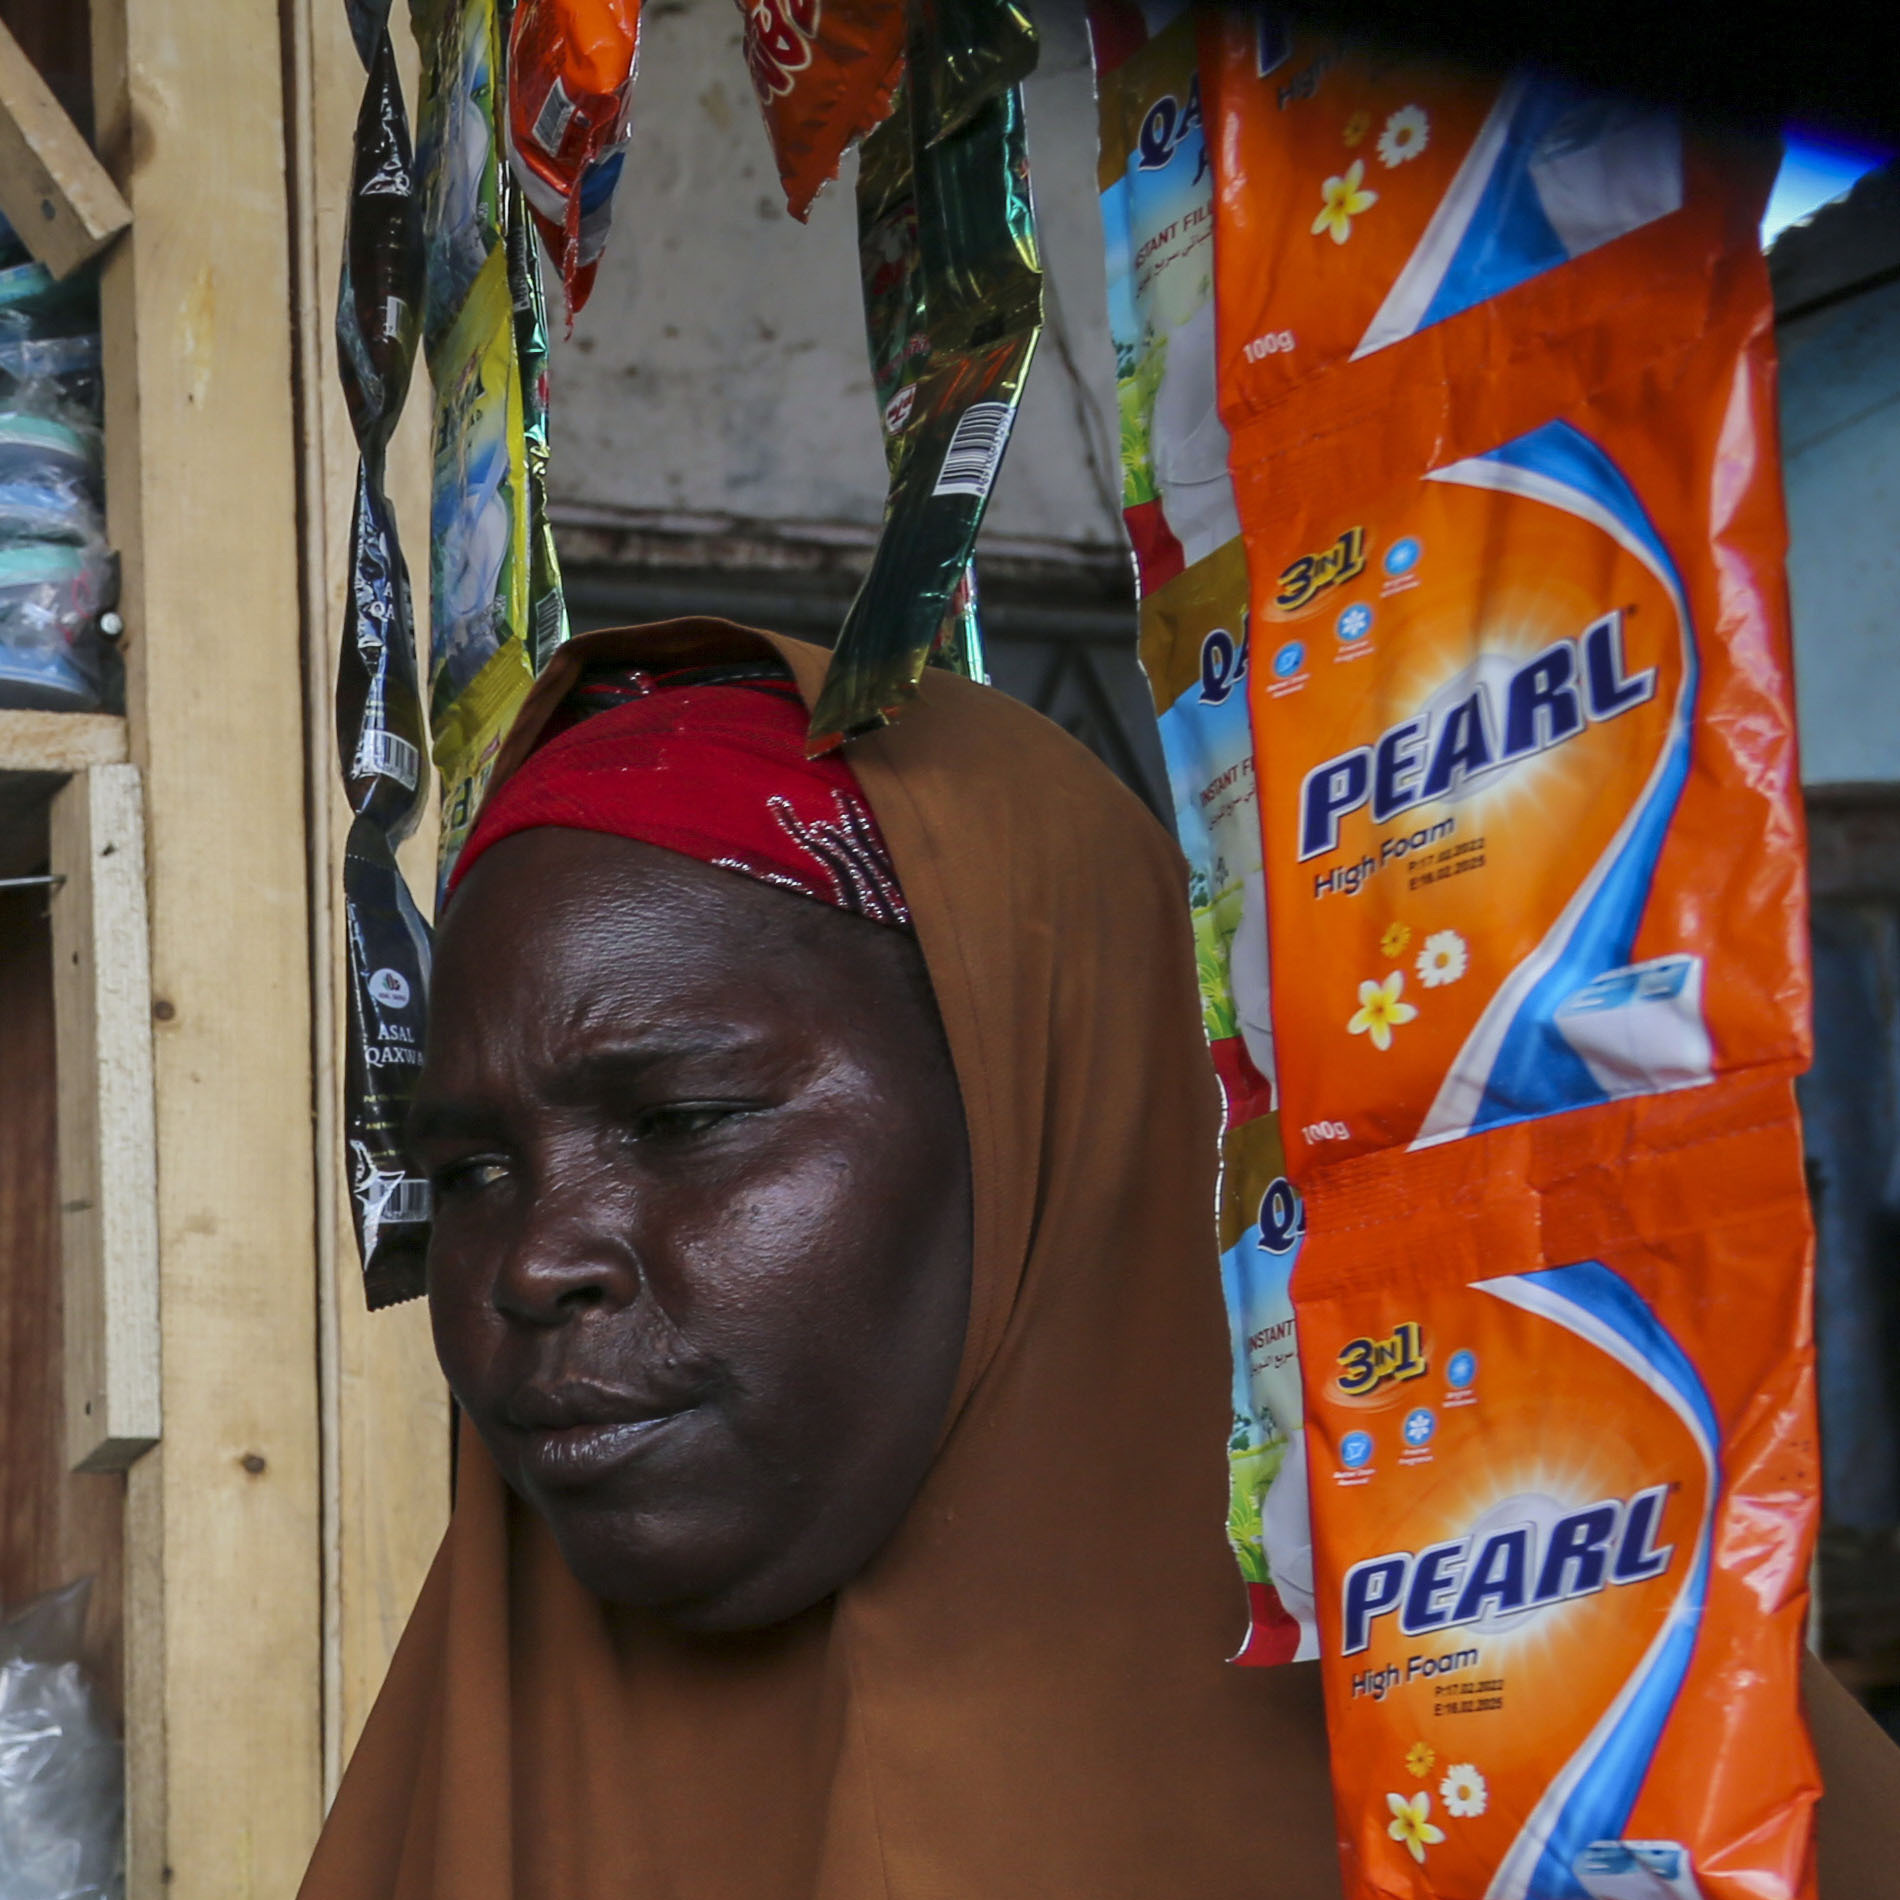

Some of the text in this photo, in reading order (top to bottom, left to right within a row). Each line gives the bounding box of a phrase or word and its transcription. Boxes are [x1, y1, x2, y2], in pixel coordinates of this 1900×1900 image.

[1242, 328, 1297, 364] 100g
[1298, 609, 1657, 864] PEARL
[1314, 817, 1456, 900] High Foam
[378, 1022, 416, 1043] ASAL
[1302, 1120, 1351, 1146] 100g
[1342, 1483, 1674, 1657] PEARL
[1352, 1648, 1478, 1701] High Foam
